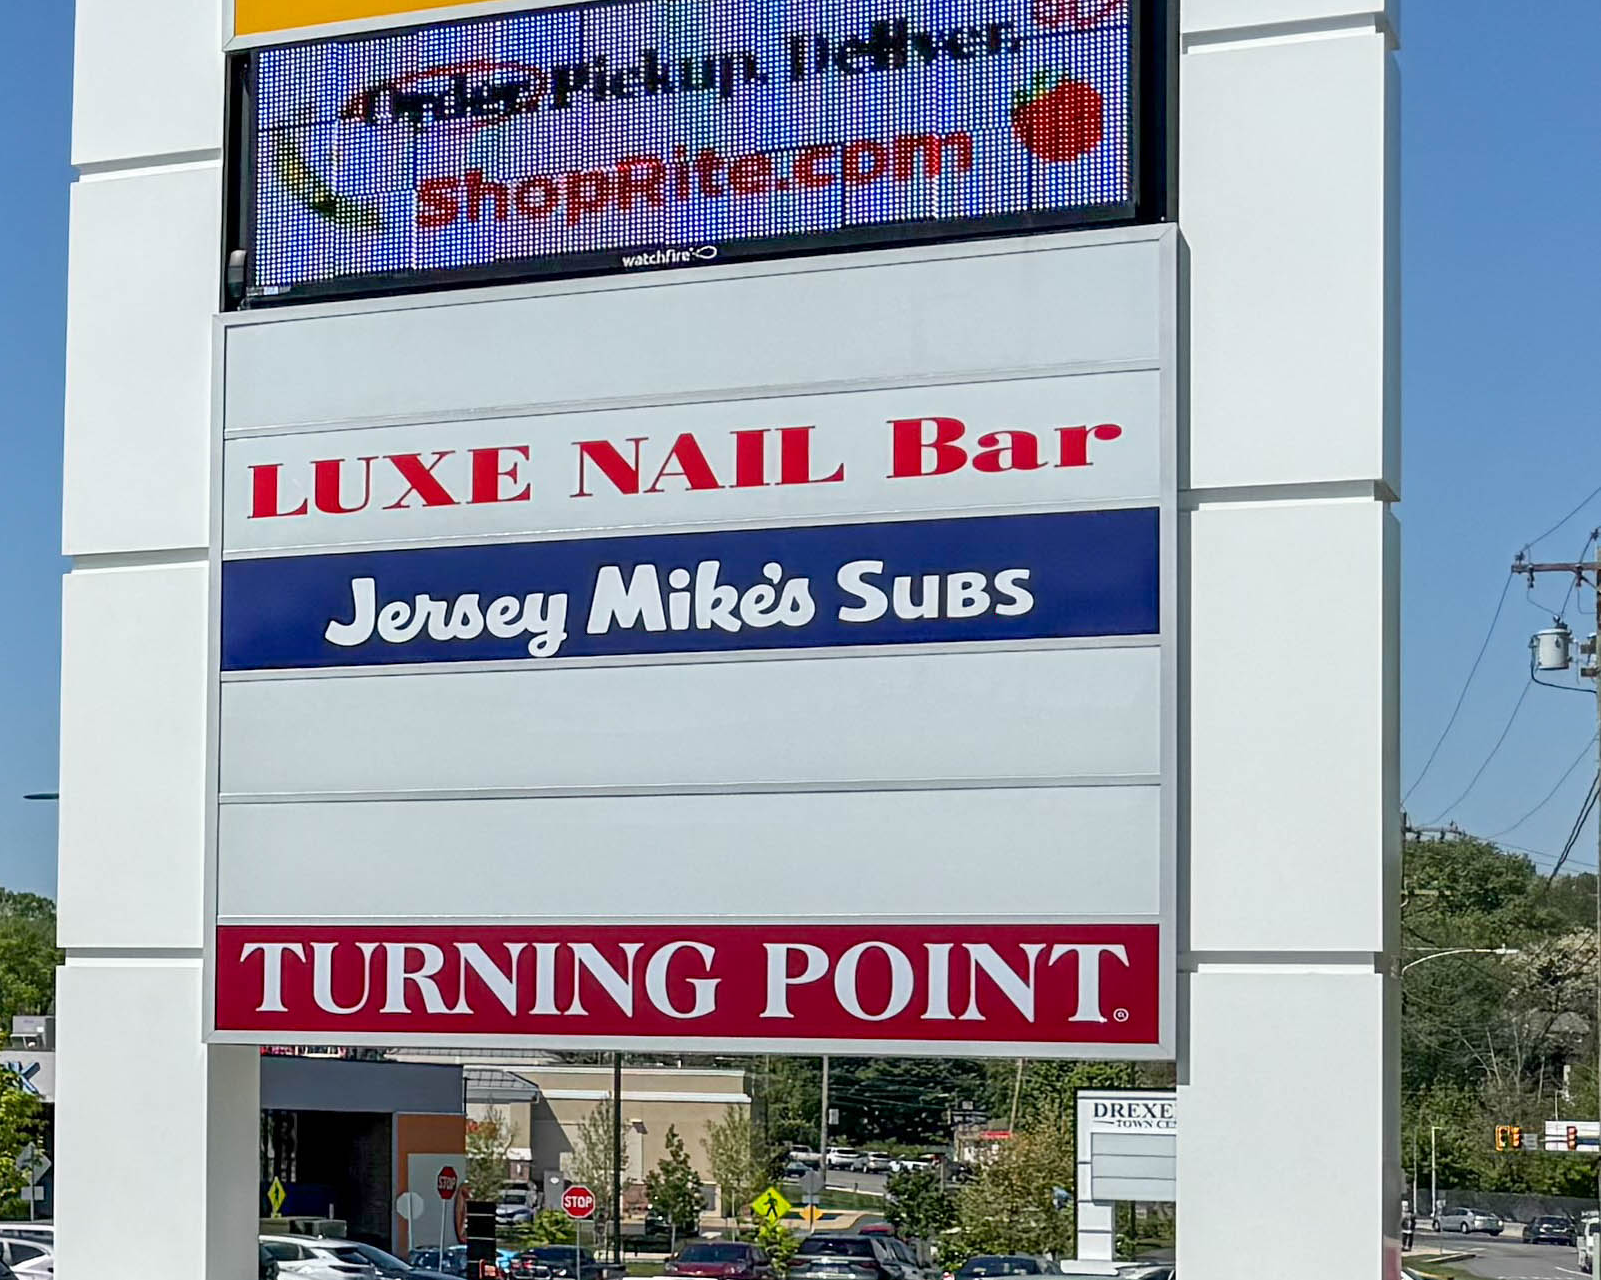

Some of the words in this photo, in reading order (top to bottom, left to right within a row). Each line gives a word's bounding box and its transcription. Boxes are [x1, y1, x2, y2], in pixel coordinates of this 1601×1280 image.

[622, 249, 690, 267] watchfire
[247, 445, 531, 519] LUXE
[569, 424, 846, 498] NAIL
[885, 416, 1122, 479] Bar
[324, 577, 568, 658] Jersey
[586, 559, 816, 634] Mike's
[837, 560, 1034, 622] SUBS
[240, 941, 722, 1019] TURNING
[759, 942, 1129, 1023] POINT
[1093, 1102, 1175, 1119] DREXE
[1116, 1119, 1153, 1128] TOWN
[1156, 1120, 1177, 1129] CE
[438, 1175, 457, 1190] STOP
[564, 1196, 592, 1208] STOP
